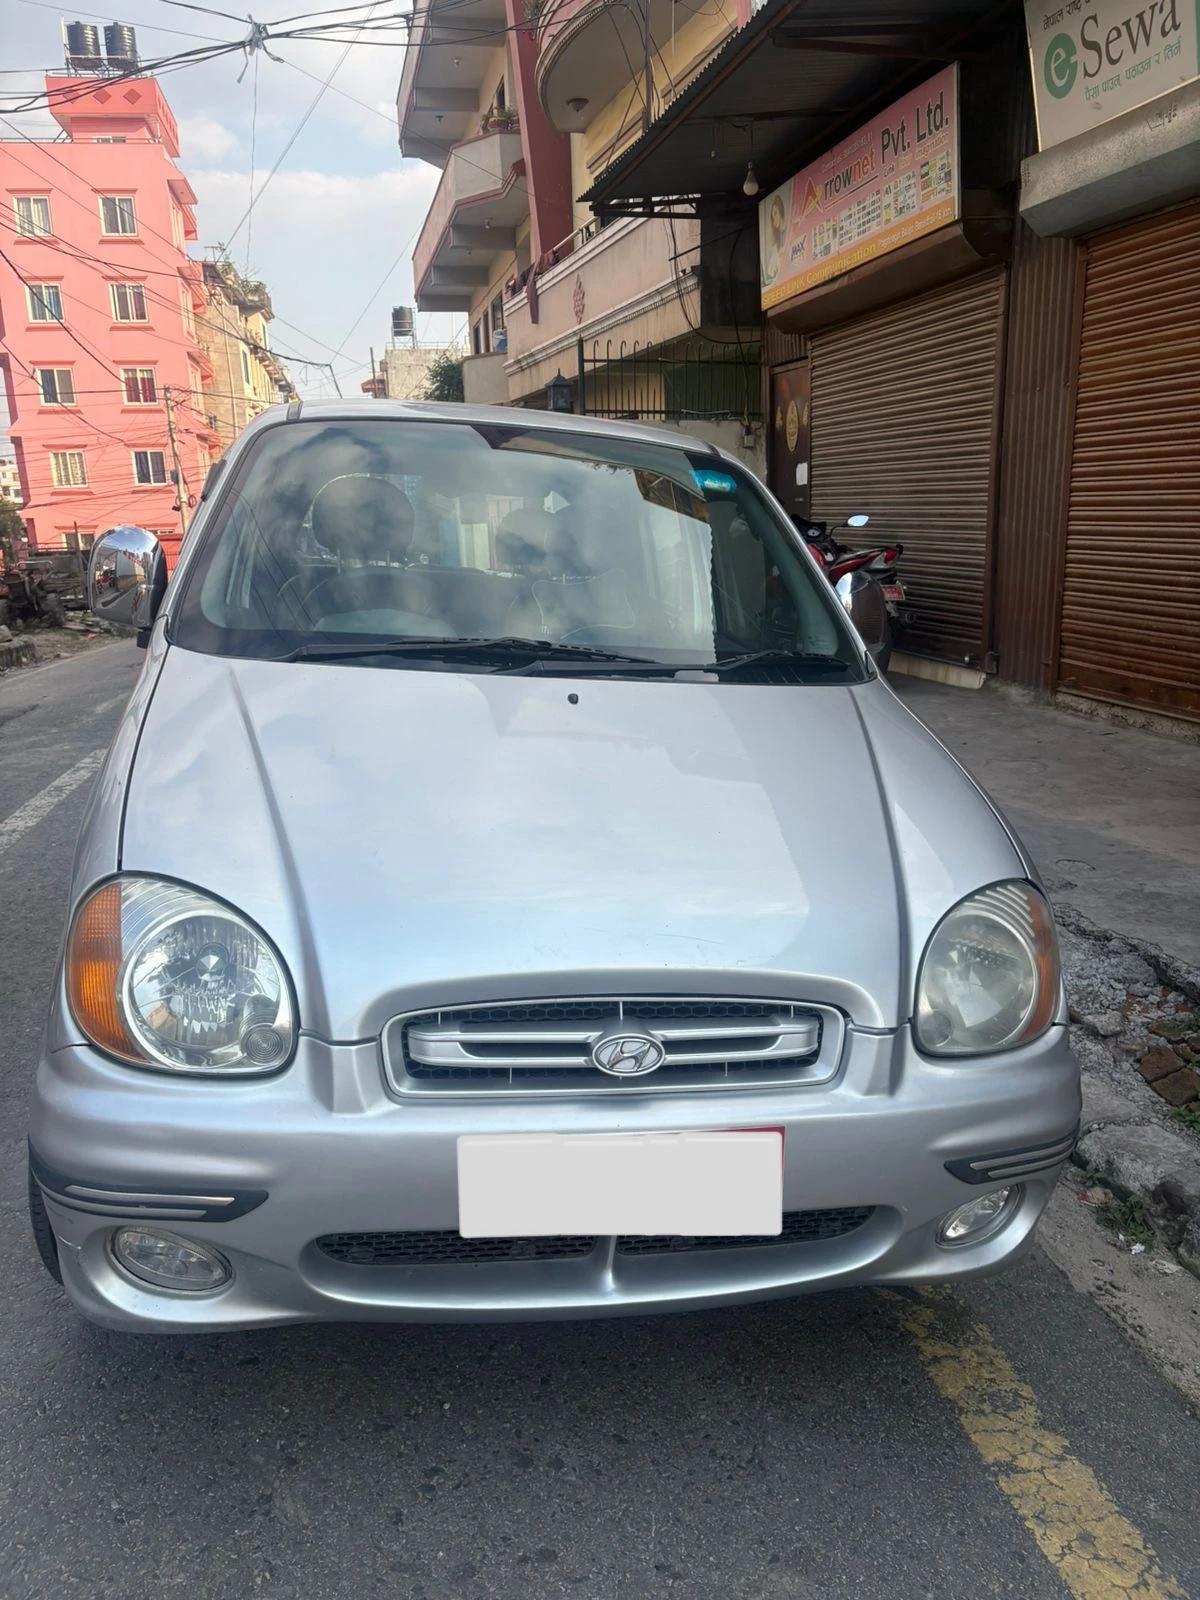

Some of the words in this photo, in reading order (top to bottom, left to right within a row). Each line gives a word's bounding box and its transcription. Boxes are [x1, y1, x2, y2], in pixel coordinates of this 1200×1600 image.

[1043, 11, 1064, 30] नेपाल
[880, 119, 910, 164] Pvt.
[916, 91, 949, 143] Ltd.
[806, 243, 877, 285] Communication
